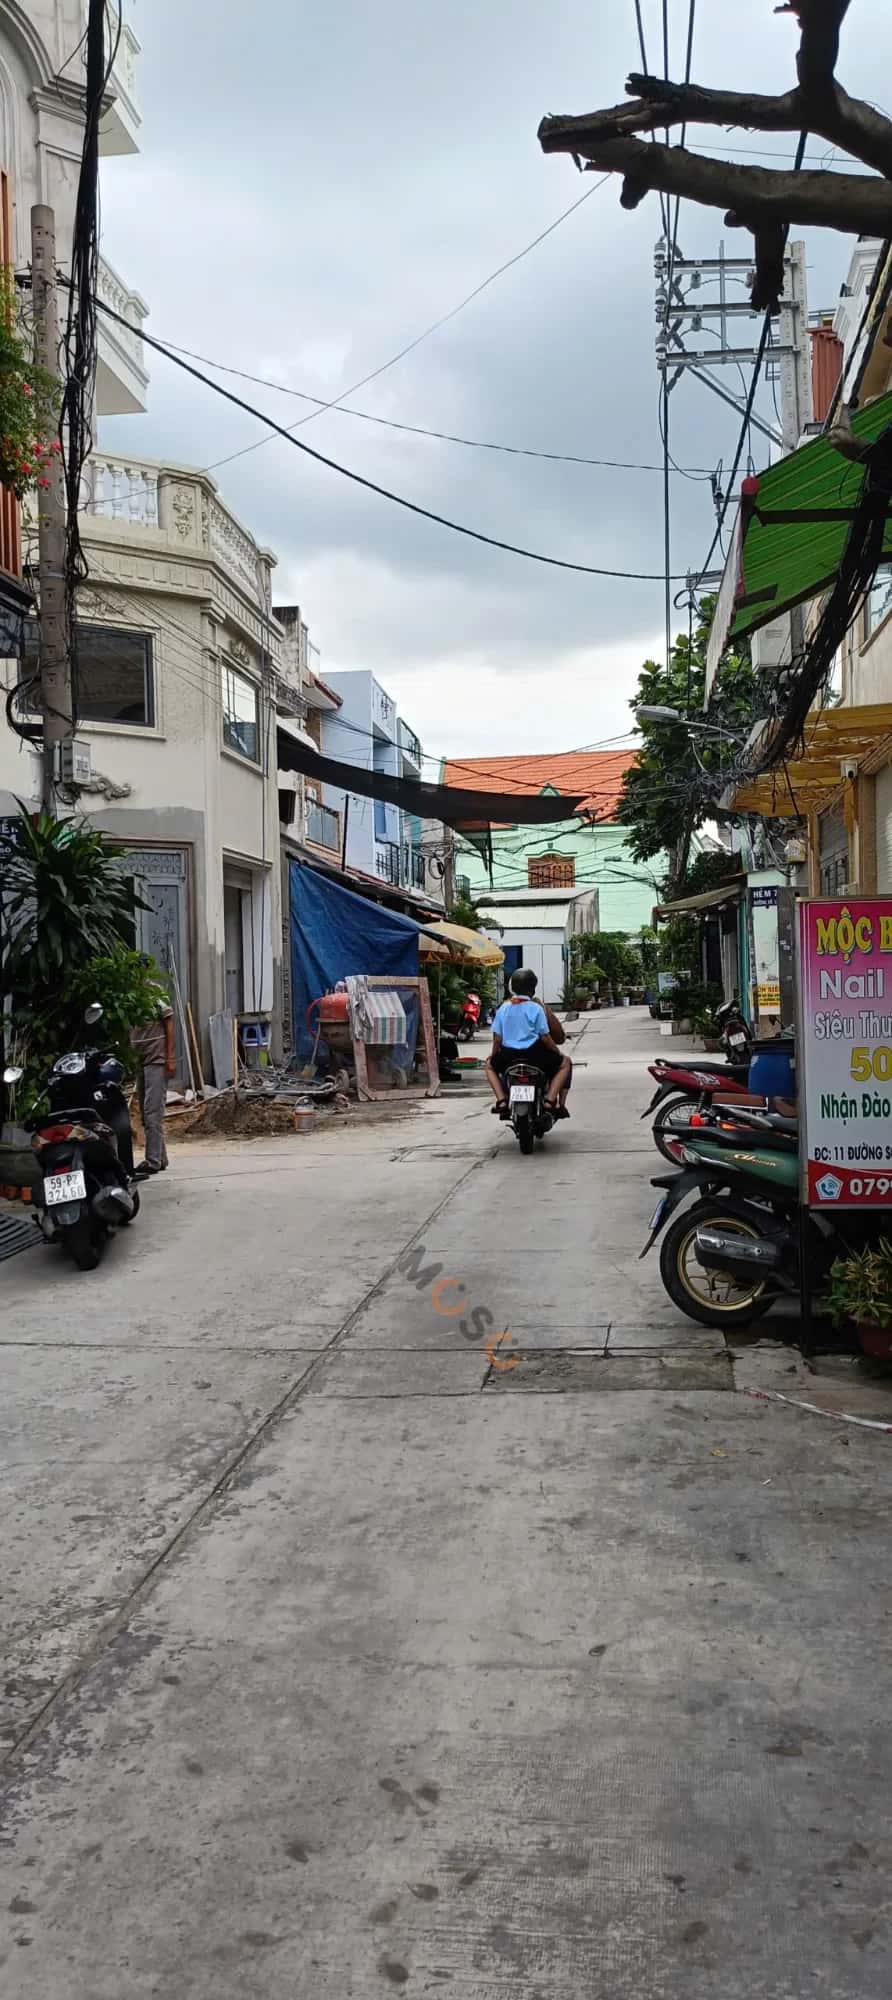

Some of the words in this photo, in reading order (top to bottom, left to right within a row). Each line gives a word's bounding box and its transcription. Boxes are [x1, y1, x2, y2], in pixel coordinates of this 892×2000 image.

[753, 888, 771, 898] HẺM
[816, 906, 872, 964] MỘC
[820, 968, 884, 999] Nail
[815, 1011, 854, 1039] Siêu
[821, 1091, 857, 1126] Nhận
[862, 1091, 890, 1118] Đào
[814, 1147, 831, 1160] ĐC:
[834, 1146, 844, 1160] 11
[848, 1142, 883, 1160] ĐƯỜNG
[885, 1145, 892, 1160] S
[849, 1178, 892, 1196] 079
